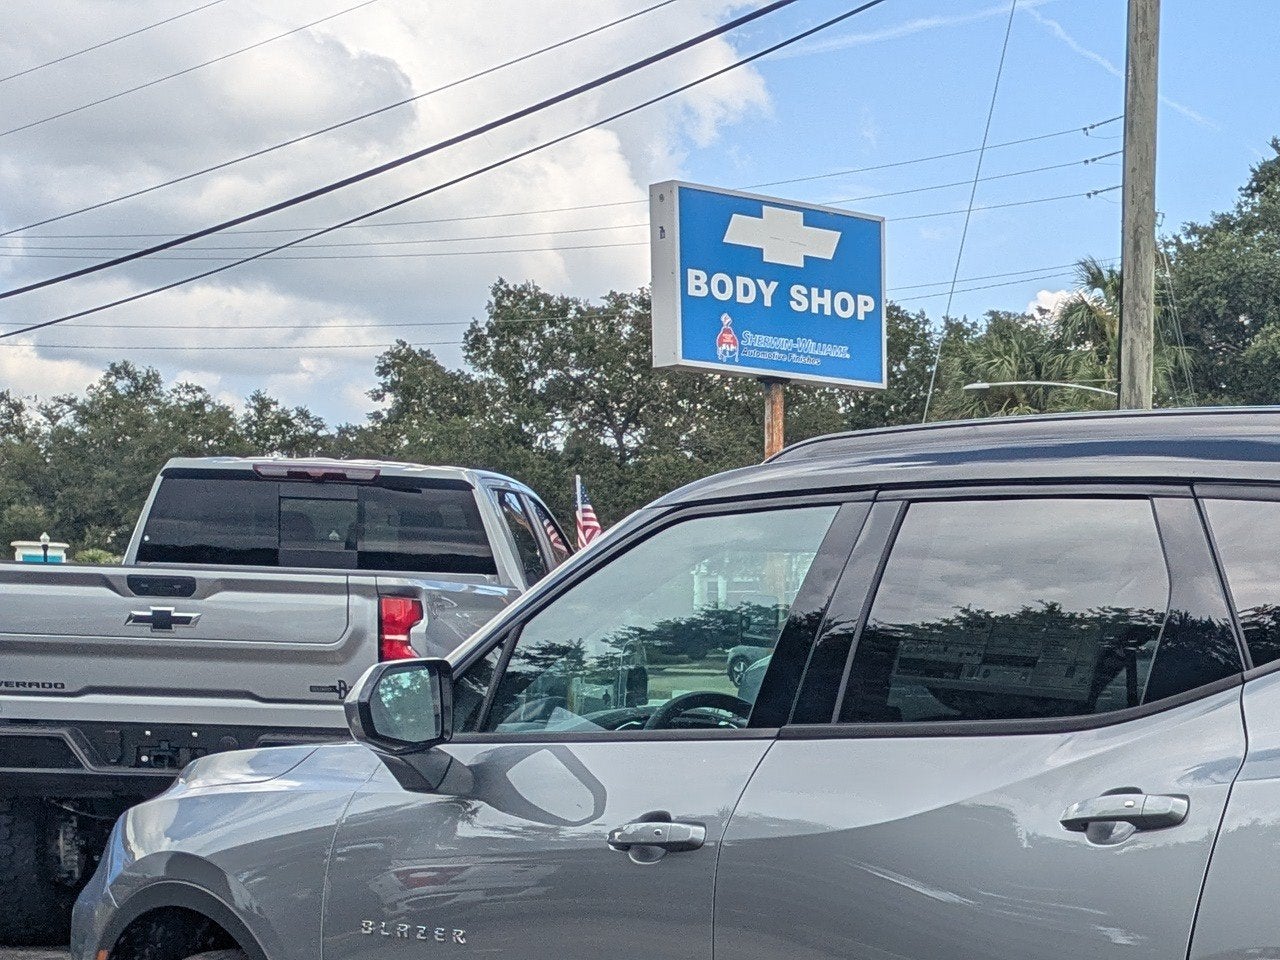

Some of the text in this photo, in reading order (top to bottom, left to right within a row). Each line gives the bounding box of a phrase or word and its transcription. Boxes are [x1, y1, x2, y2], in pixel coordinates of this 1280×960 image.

[686, 268, 875, 321] BODY SHOP
[741, 347, 788, 362] Automotive
[361, 920, 467, 944] BLAZER
